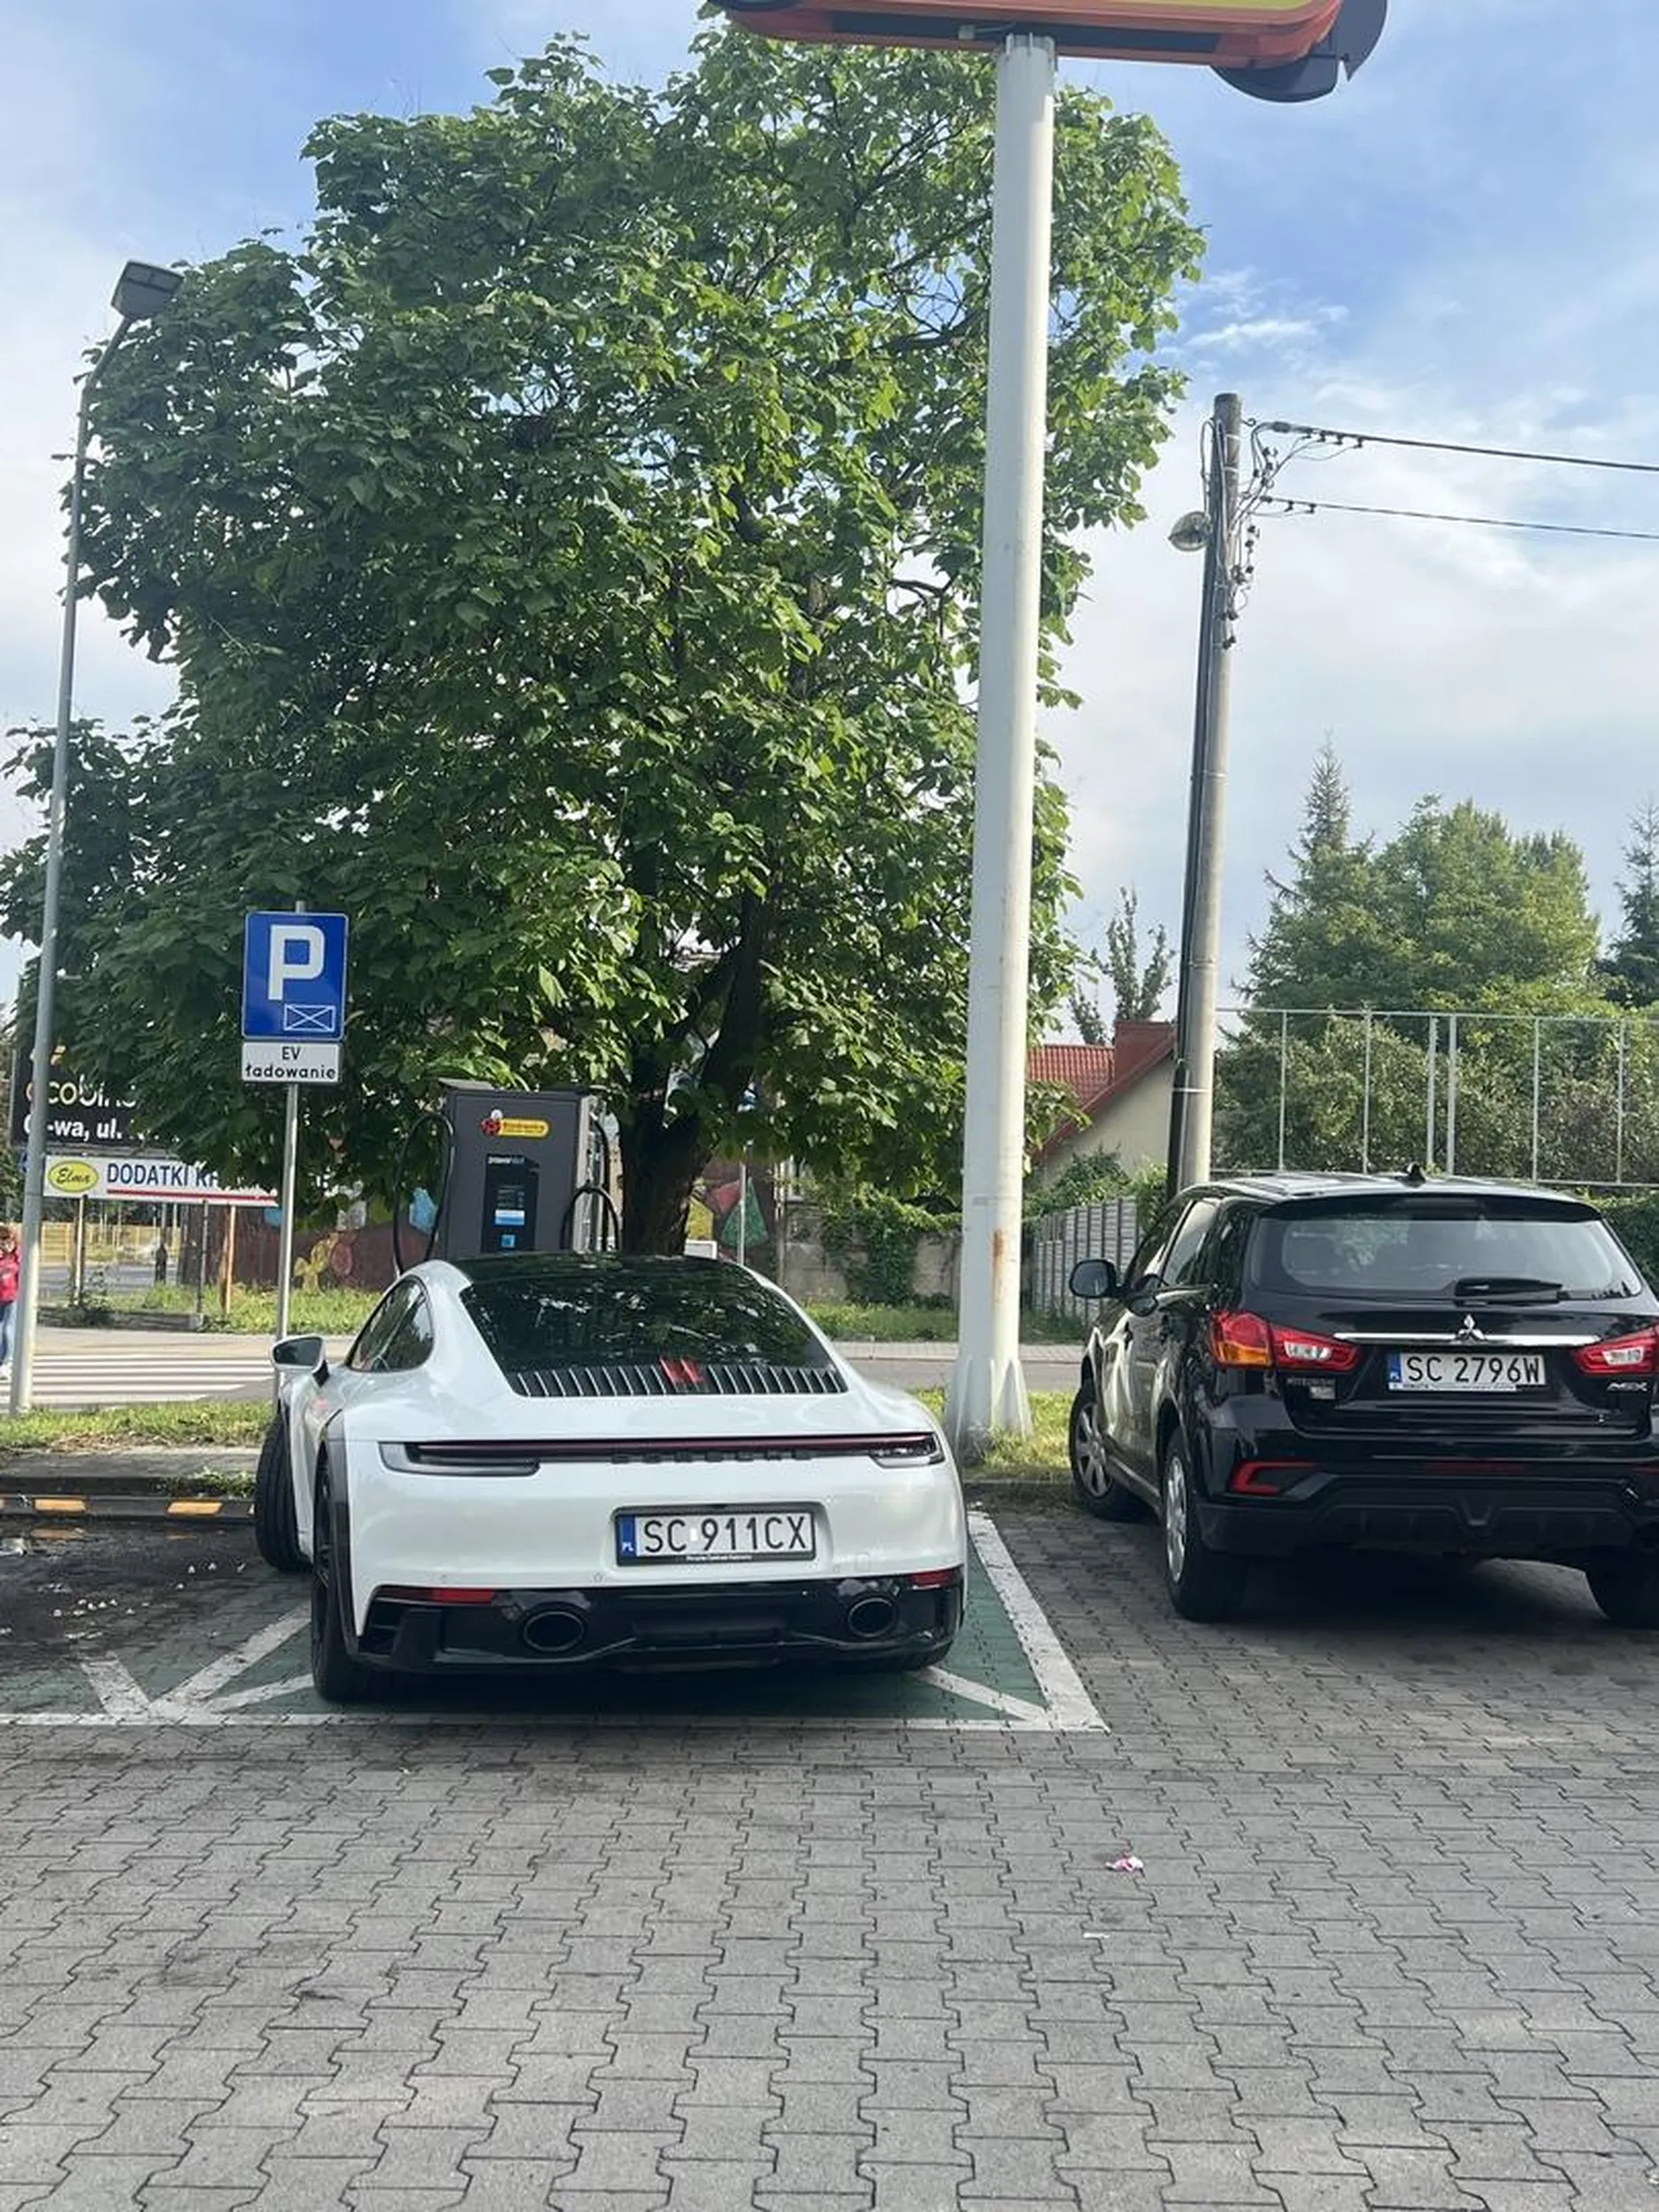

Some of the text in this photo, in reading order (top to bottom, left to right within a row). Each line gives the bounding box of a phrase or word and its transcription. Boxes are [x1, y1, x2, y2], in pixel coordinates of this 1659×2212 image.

[267, 924, 326, 1001] P
[280, 1046, 302, 1061] EV
[244, 1064, 337, 1079] ładowanie
[24, 1114, 89, 1142] -wa,
[96, 1118, 122, 1140] ul.
[107, 1163, 188, 1187] DODATKI
[1406, 1356, 1540, 1384] SC 2796W
[643, 1515, 808, 1553] SC 911CX
